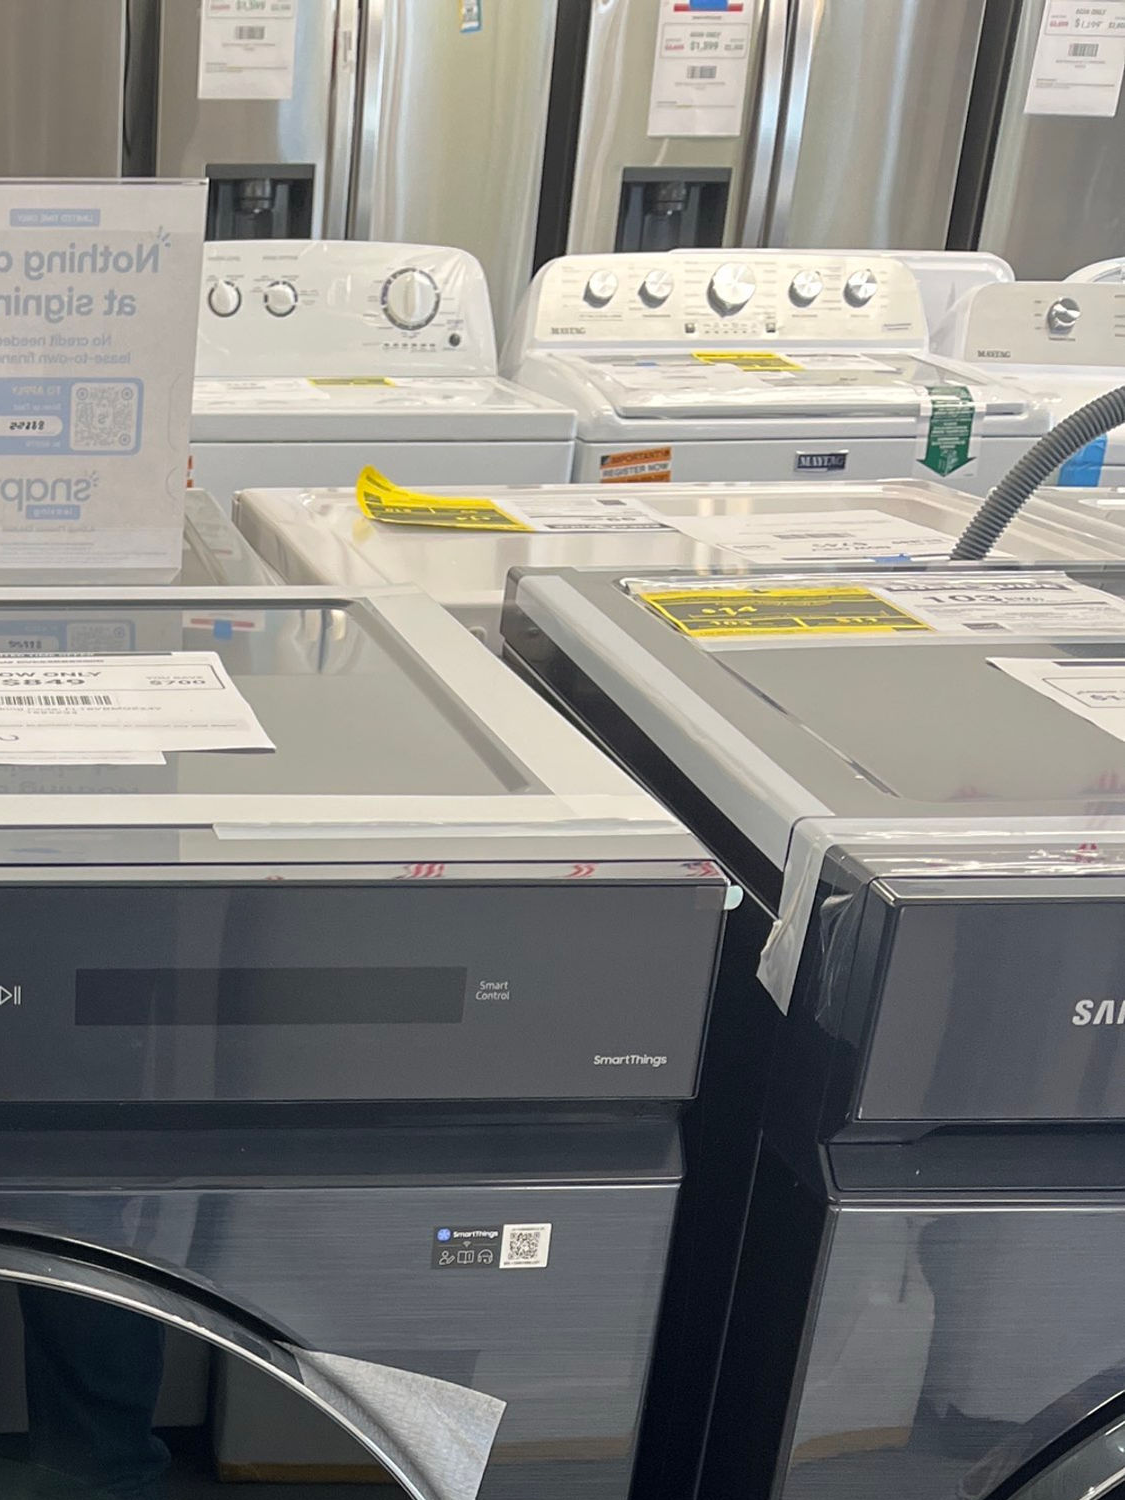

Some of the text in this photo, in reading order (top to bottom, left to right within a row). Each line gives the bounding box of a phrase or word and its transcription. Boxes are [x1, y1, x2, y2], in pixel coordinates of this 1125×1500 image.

[799, 454, 845, 468] MAYTAG
[603, 462, 670, 477] REGISTER NOW
[922, 594, 1003, 603] 103
[1, 678, 86, 687] $849
[149, 678, 206, 686] $700
[479, 980, 509, 991] Smart
[475, 991, 510, 1001] Control
[1072, 1000, 1125, 1027] SA
[593, 1054, 668, 1068] SmartThings
[453, 1230, 499, 1240] SmartThings
